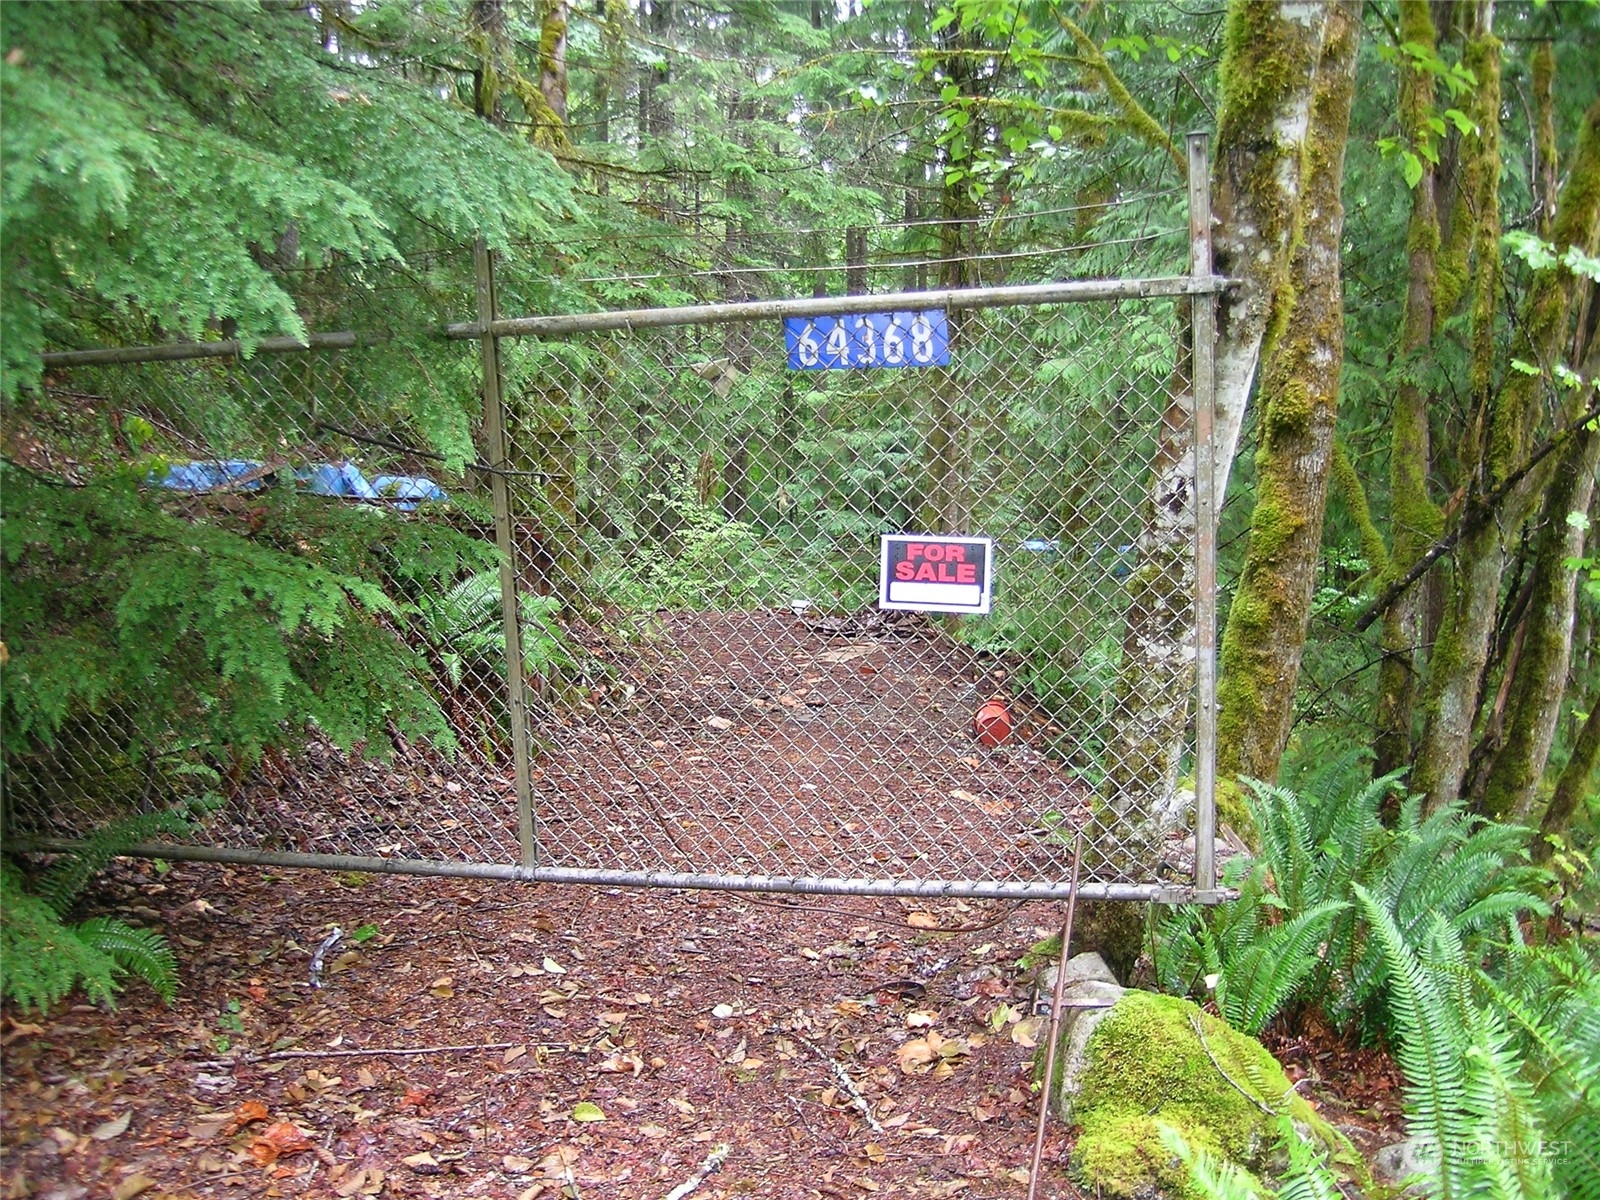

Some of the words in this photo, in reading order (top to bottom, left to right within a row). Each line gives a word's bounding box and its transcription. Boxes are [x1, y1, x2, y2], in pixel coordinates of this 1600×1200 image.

[798, 314, 932, 366] 64368
[907, 544, 964, 562] FOR
[895, 561, 976, 583] SALE
